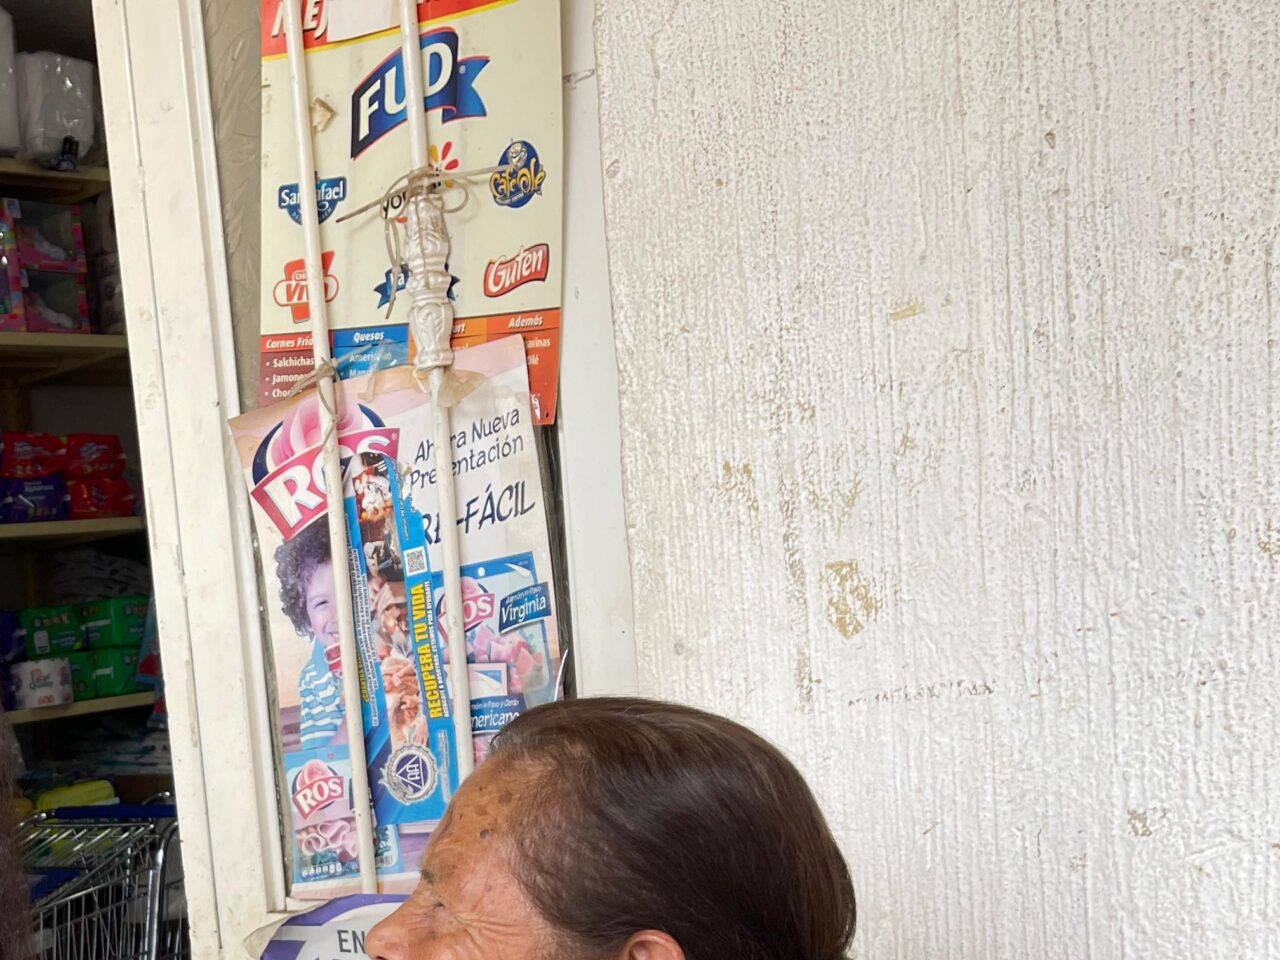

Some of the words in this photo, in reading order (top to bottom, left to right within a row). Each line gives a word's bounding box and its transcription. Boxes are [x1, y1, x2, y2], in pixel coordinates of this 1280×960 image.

[358, 42, 453, 141] FUD
[488, 248, 544, 293] Guten
[353, 332, 384, 343] Quesos
[508, 314, 543, 328] Además
[265, 338, 295, 349] Carnes
[273, 356, 315, 368] Salchichas
[414, 430, 467, 464] Ahra
[471, 408, 520, 443] Nueva
[410, 434, 524, 489] Preentación
[409, 583, 427, 621] VIDA
[501, 594, 547, 624] Virginia
[413, 623, 428, 643] TU
[416, 644, 443, 718] RECUPERA
[296, 778, 342, 814] ROS
